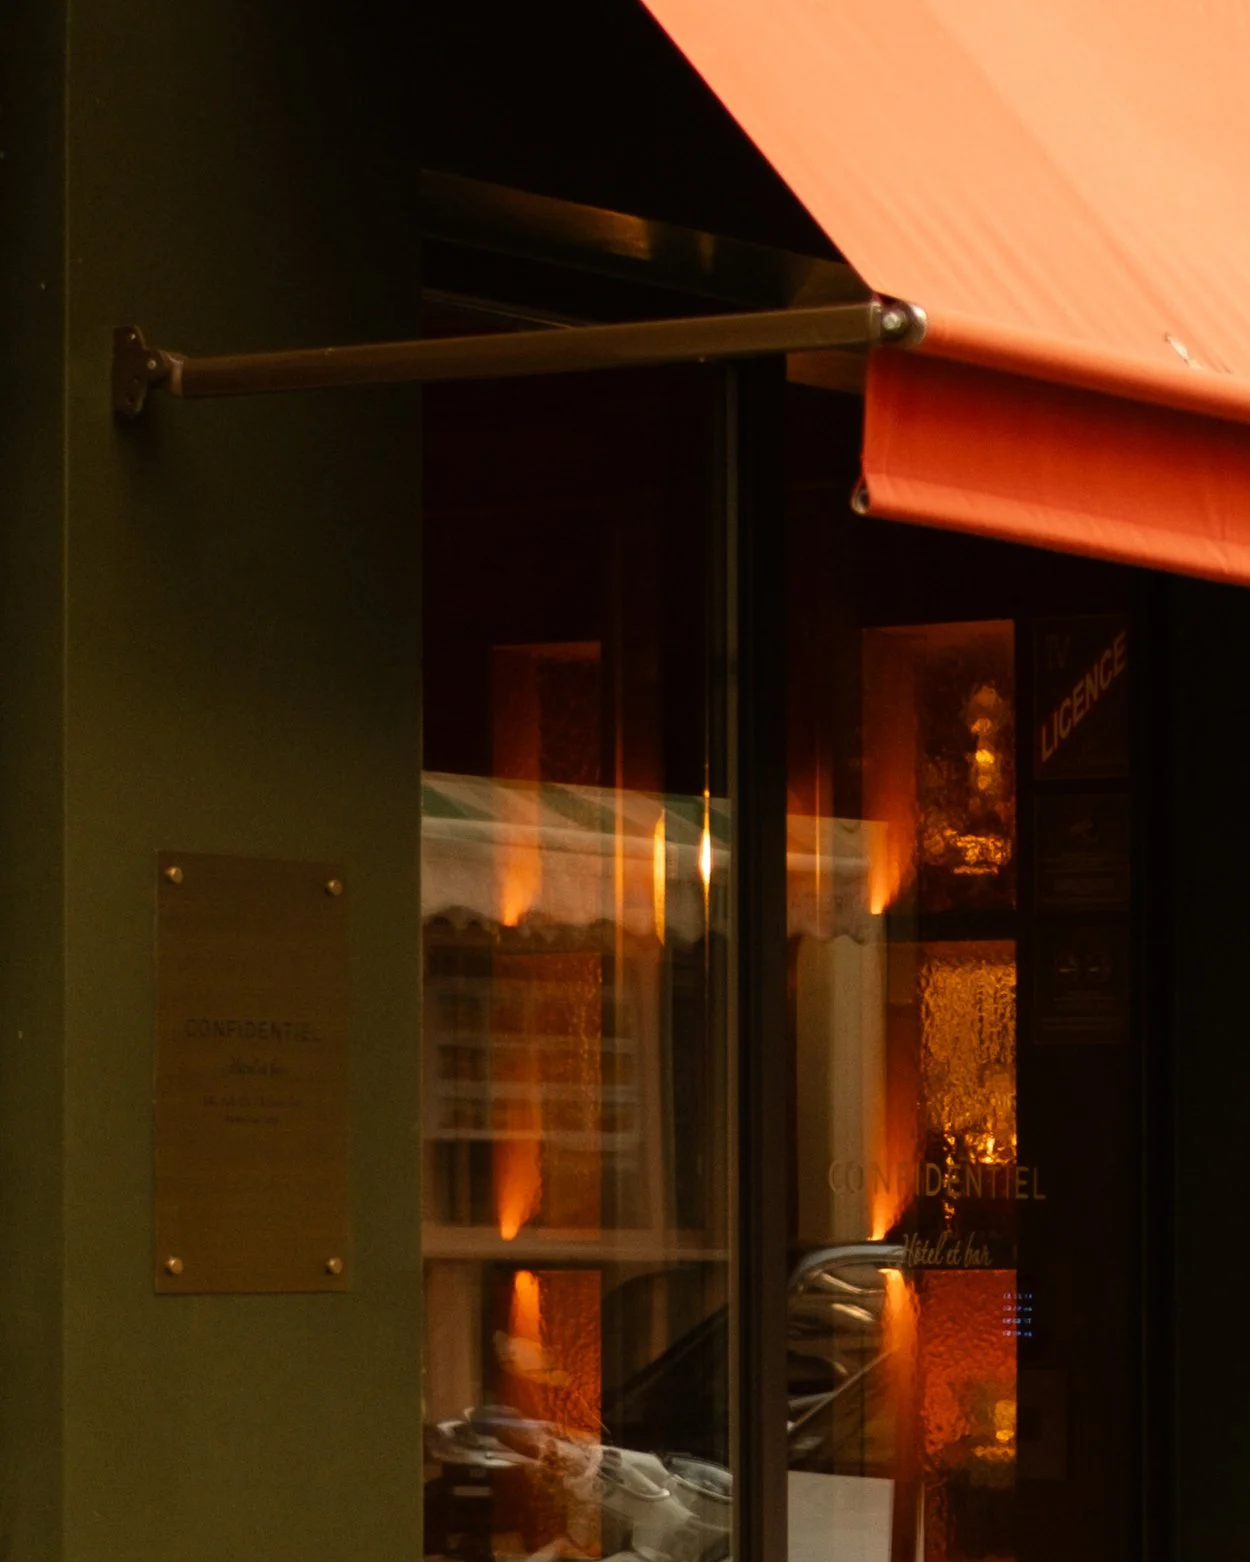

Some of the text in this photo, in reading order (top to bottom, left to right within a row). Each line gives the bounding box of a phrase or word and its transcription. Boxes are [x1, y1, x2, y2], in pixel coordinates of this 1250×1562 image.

[1040, 629, 1127, 764] LICENCE
[828, 1159, 1048, 1201] CONFIDENTIEL
[898, 1231, 995, 1268] Hôtel et bar
